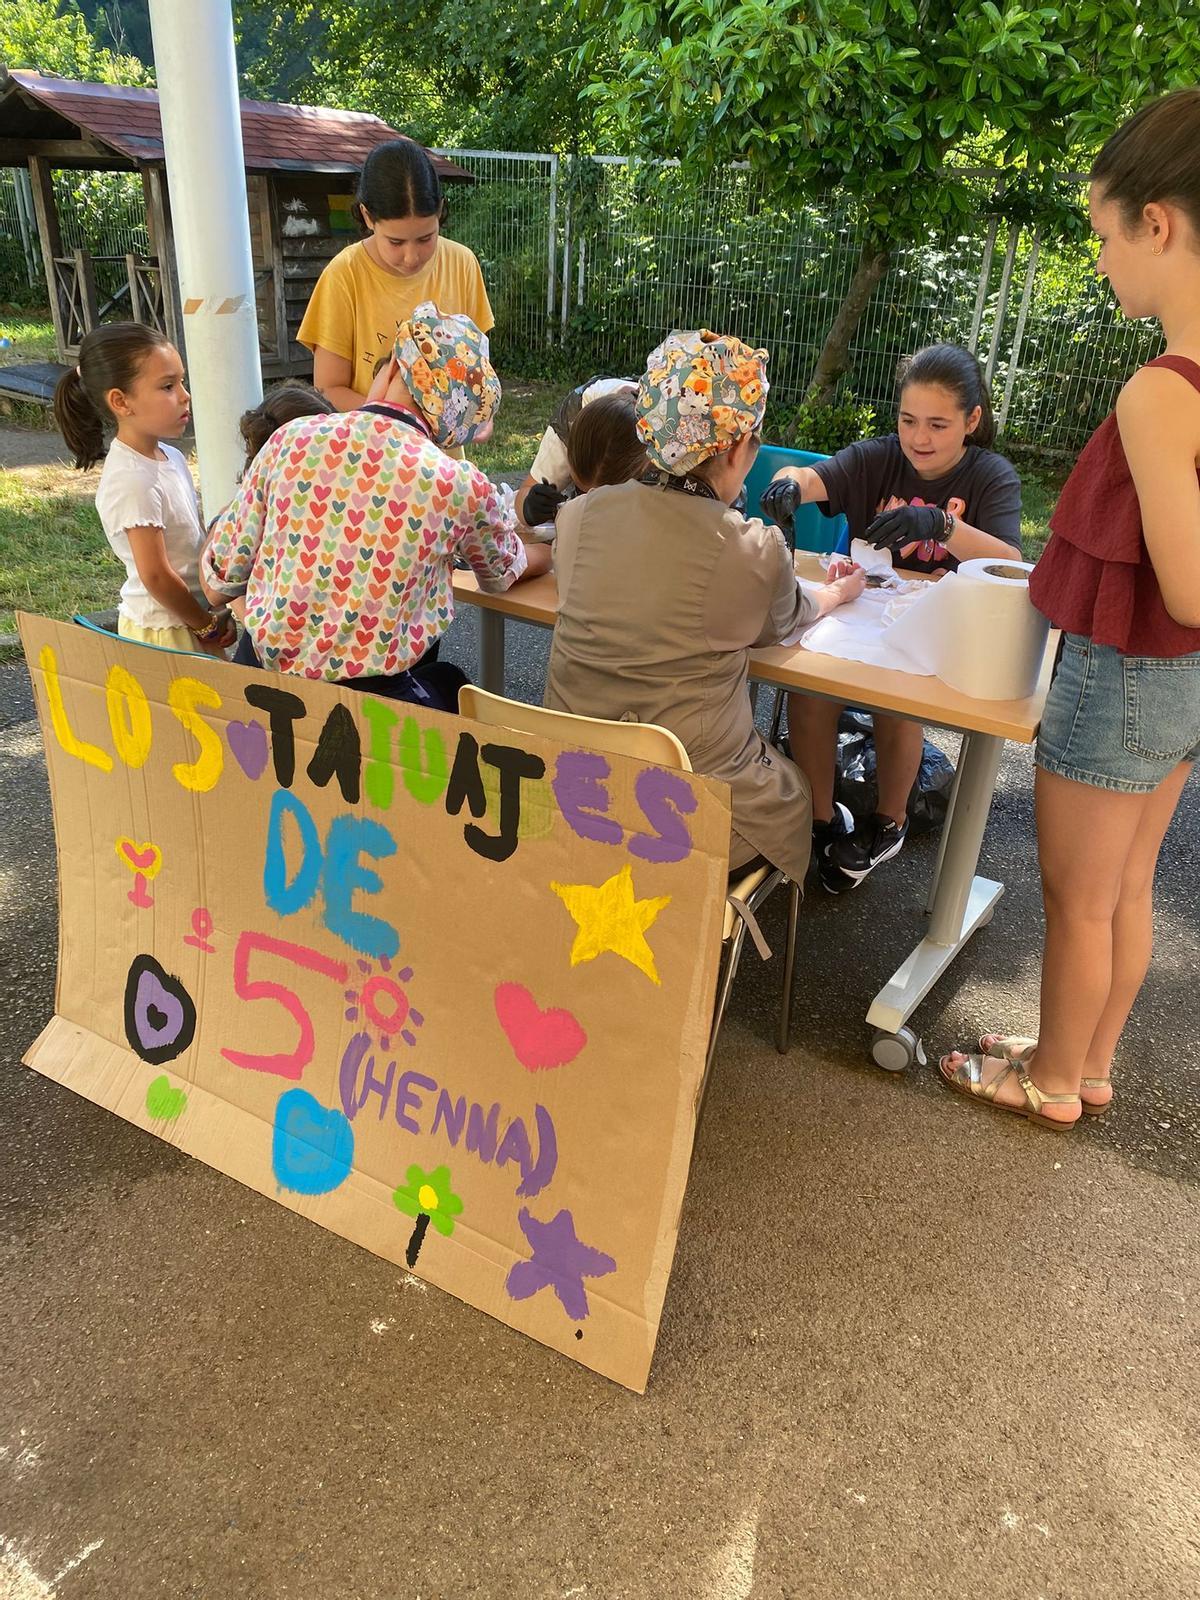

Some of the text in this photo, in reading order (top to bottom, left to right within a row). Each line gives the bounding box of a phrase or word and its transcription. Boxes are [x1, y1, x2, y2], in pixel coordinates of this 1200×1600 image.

[39, 645, 698, 864] LOS TATUAJES
[263, 788, 400, 959] DE
[339, 1032, 558, 1197] (HENNA)
